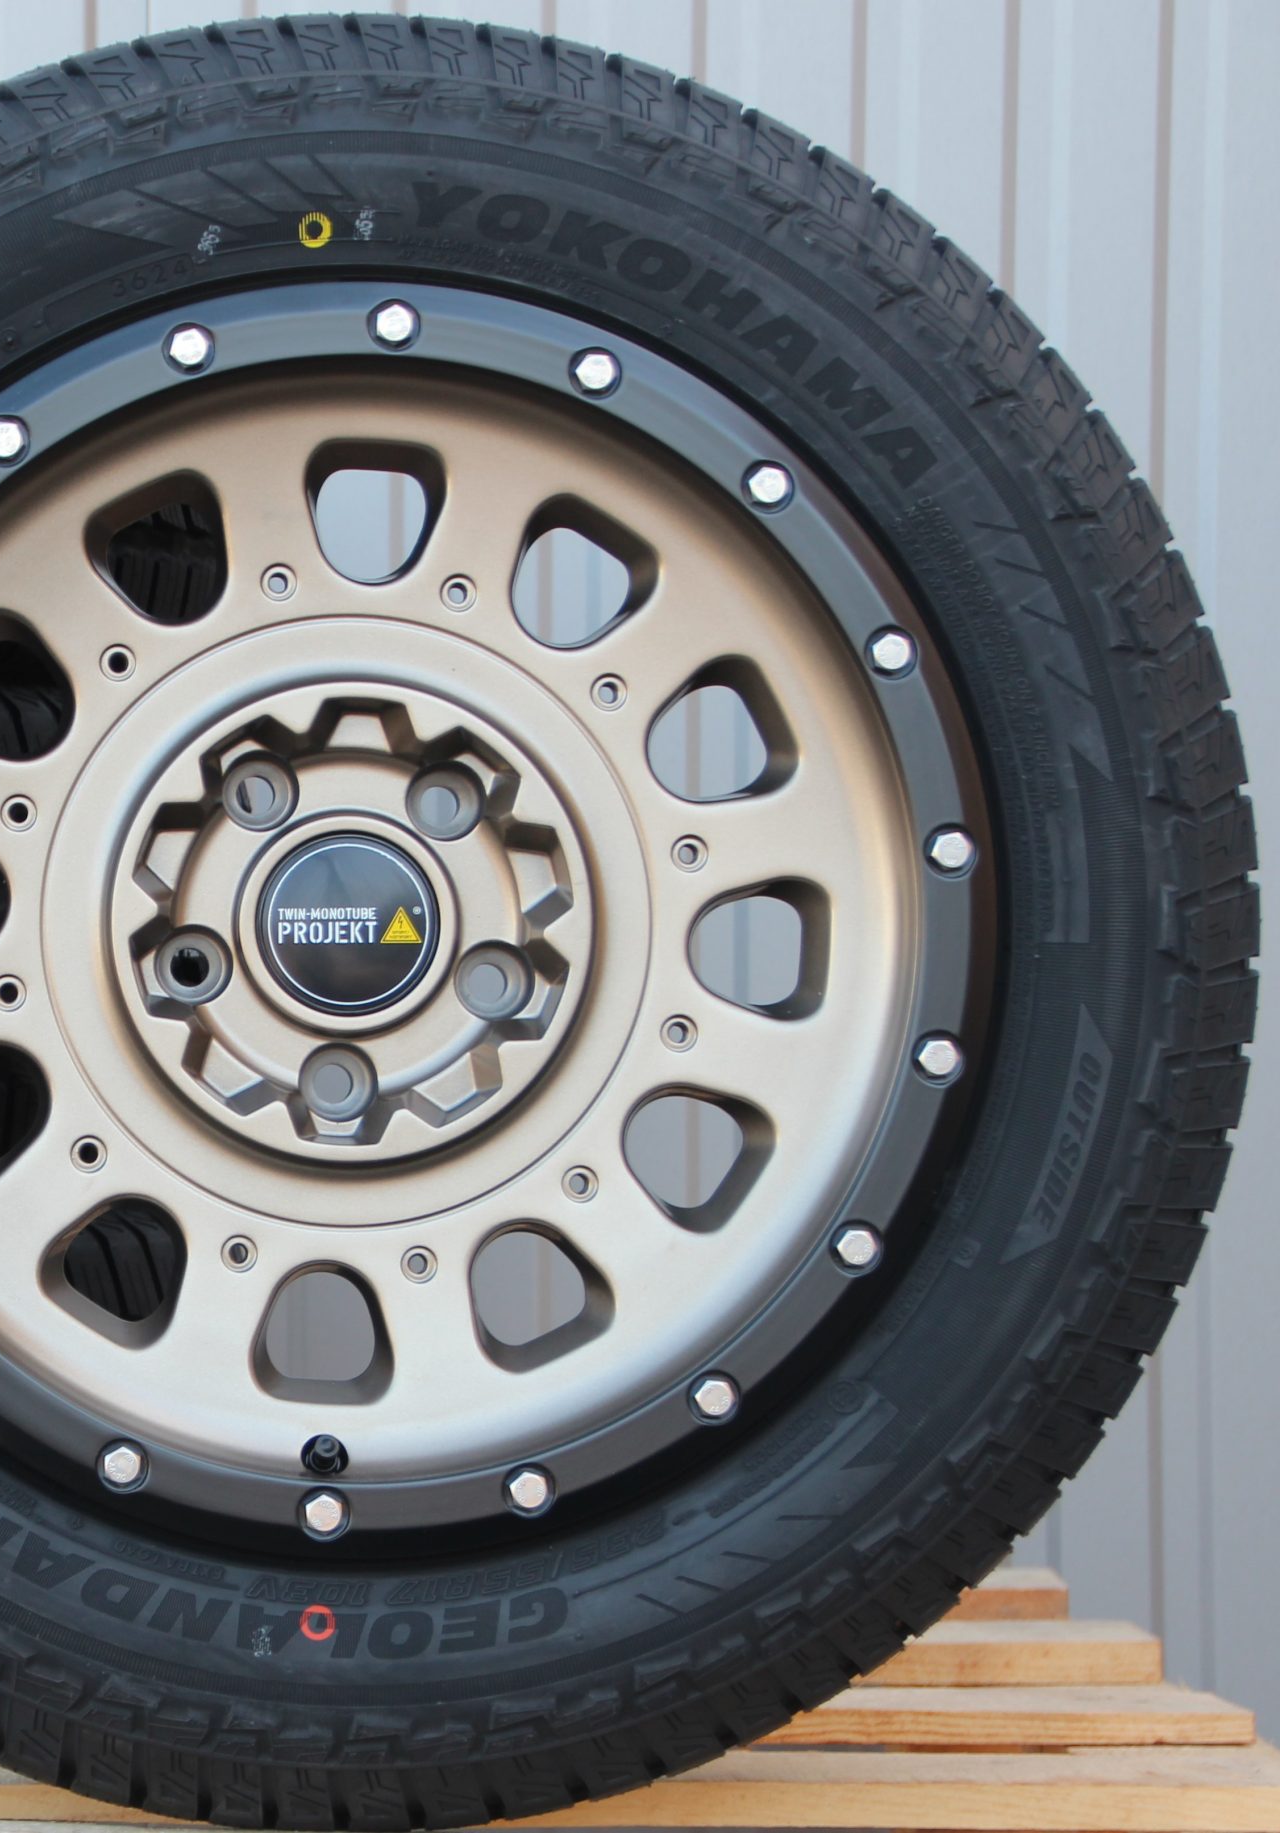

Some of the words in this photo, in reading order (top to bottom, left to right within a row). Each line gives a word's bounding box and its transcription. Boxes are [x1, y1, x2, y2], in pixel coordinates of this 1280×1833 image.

[109, 259, 186, 298] 3624
[411, 177, 938, 489] YOKOHAMA
[959, 557, 982, 584] DO
[972, 582, 999, 617] NOT
[990, 618, 1024, 674] MOUNT
[1013, 676, 1033, 701] ON
[277, 907, 377, 920] TWIN-MONOTUBE
[277, 921, 379, 944] PROJEKT
[1029, 1054, 1102, 1231] OUTSIDE
[247, 1574, 367, 1605] 103V
[387, 1509, 667, 1608] 235/55R17
